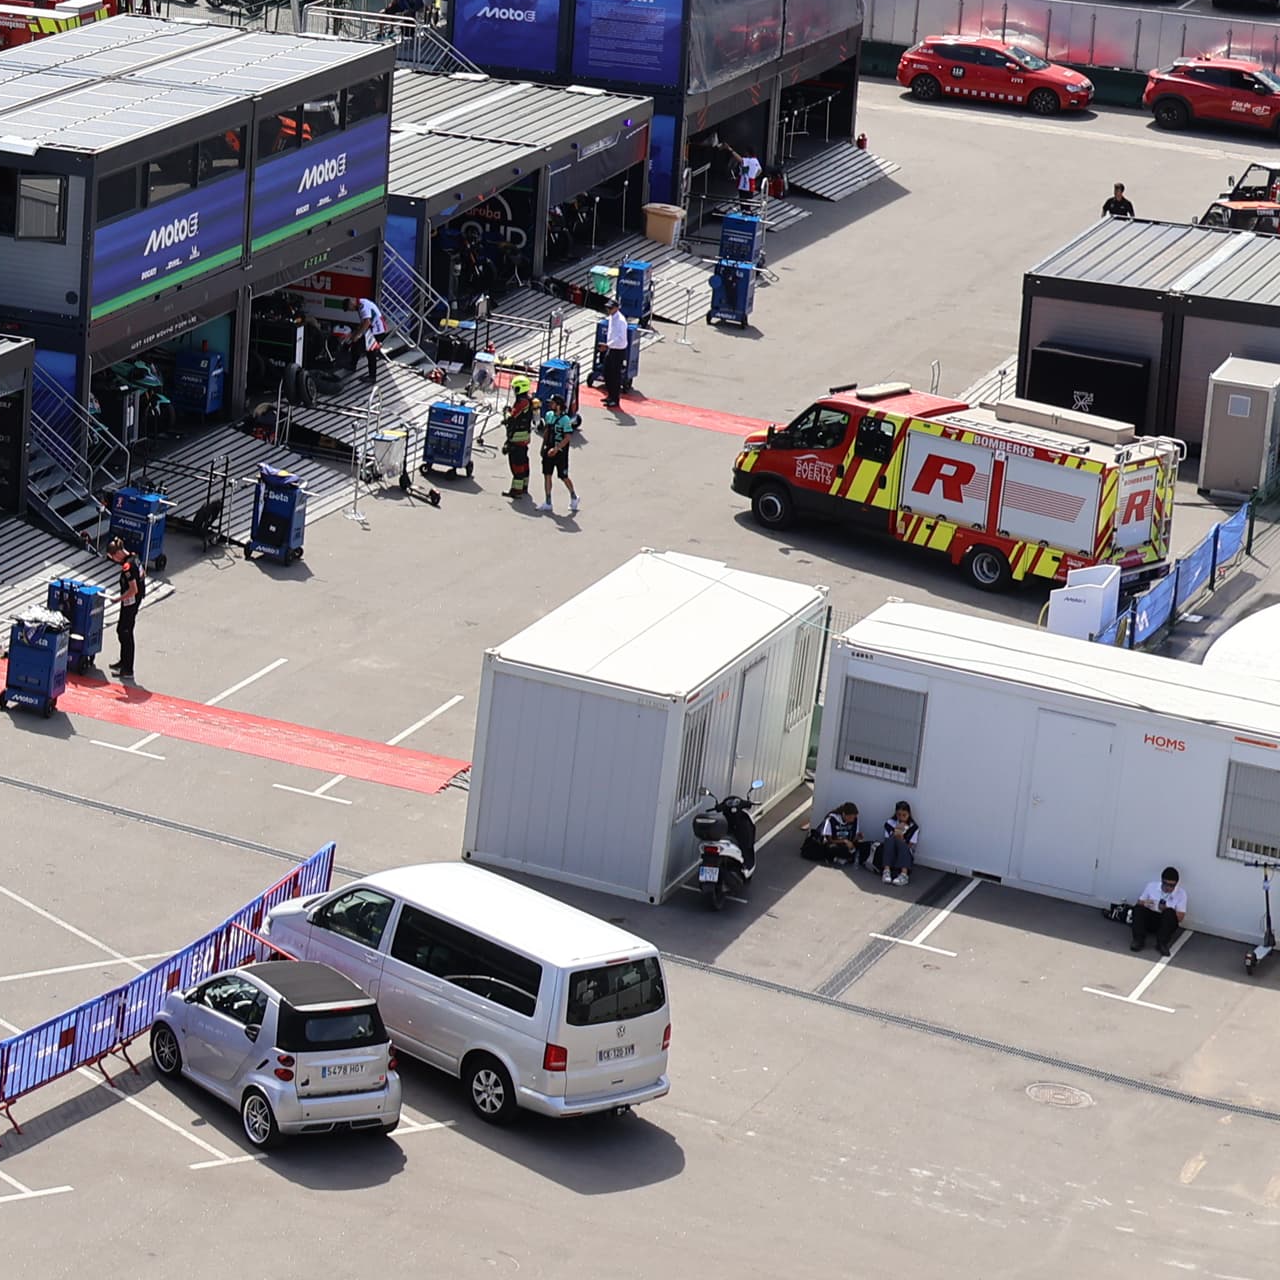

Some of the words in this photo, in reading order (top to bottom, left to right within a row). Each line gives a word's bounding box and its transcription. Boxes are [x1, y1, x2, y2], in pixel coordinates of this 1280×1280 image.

[477, 6, 536, 23] MotoE
[297, 152, 345, 194] MotoE
[144, 212, 198, 257] MotoE
[973, 434, 1036, 458] BOMBEROS
[795, 459, 833, 478] SAFETY
[795, 468, 831, 486] EVENTS
[912, 453, 978, 504] R
[1122, 489, 1151, 525] R
[1144, 733, 1186, 752] HOMS
[327, 1065, 348, 1077] 5478
